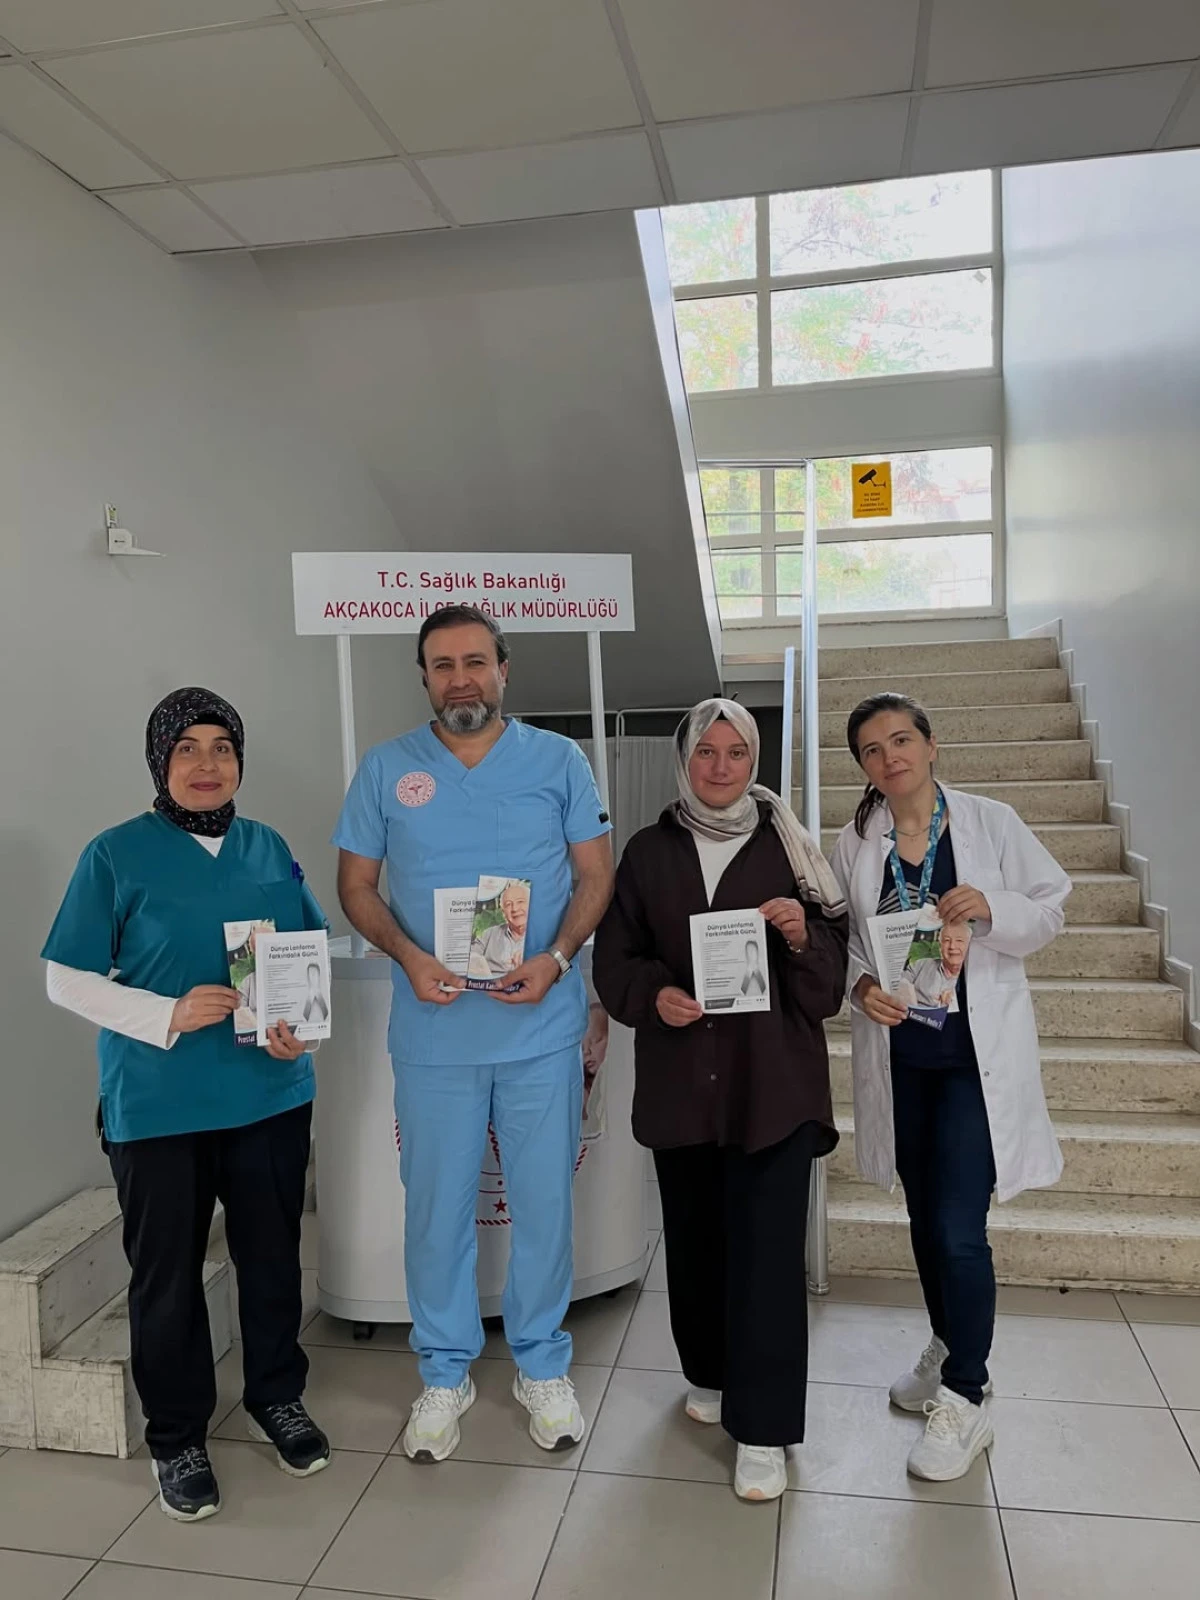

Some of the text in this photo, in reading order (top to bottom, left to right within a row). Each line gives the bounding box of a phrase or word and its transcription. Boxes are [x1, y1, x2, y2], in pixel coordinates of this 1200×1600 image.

[377, 571, 566, 593] T.C. Sağlık Bakanlığı
[324, 601, 416, 620] AKÇAKOCA
[521, 598, 619, 618] MÜDÜRLÜĞÜ
